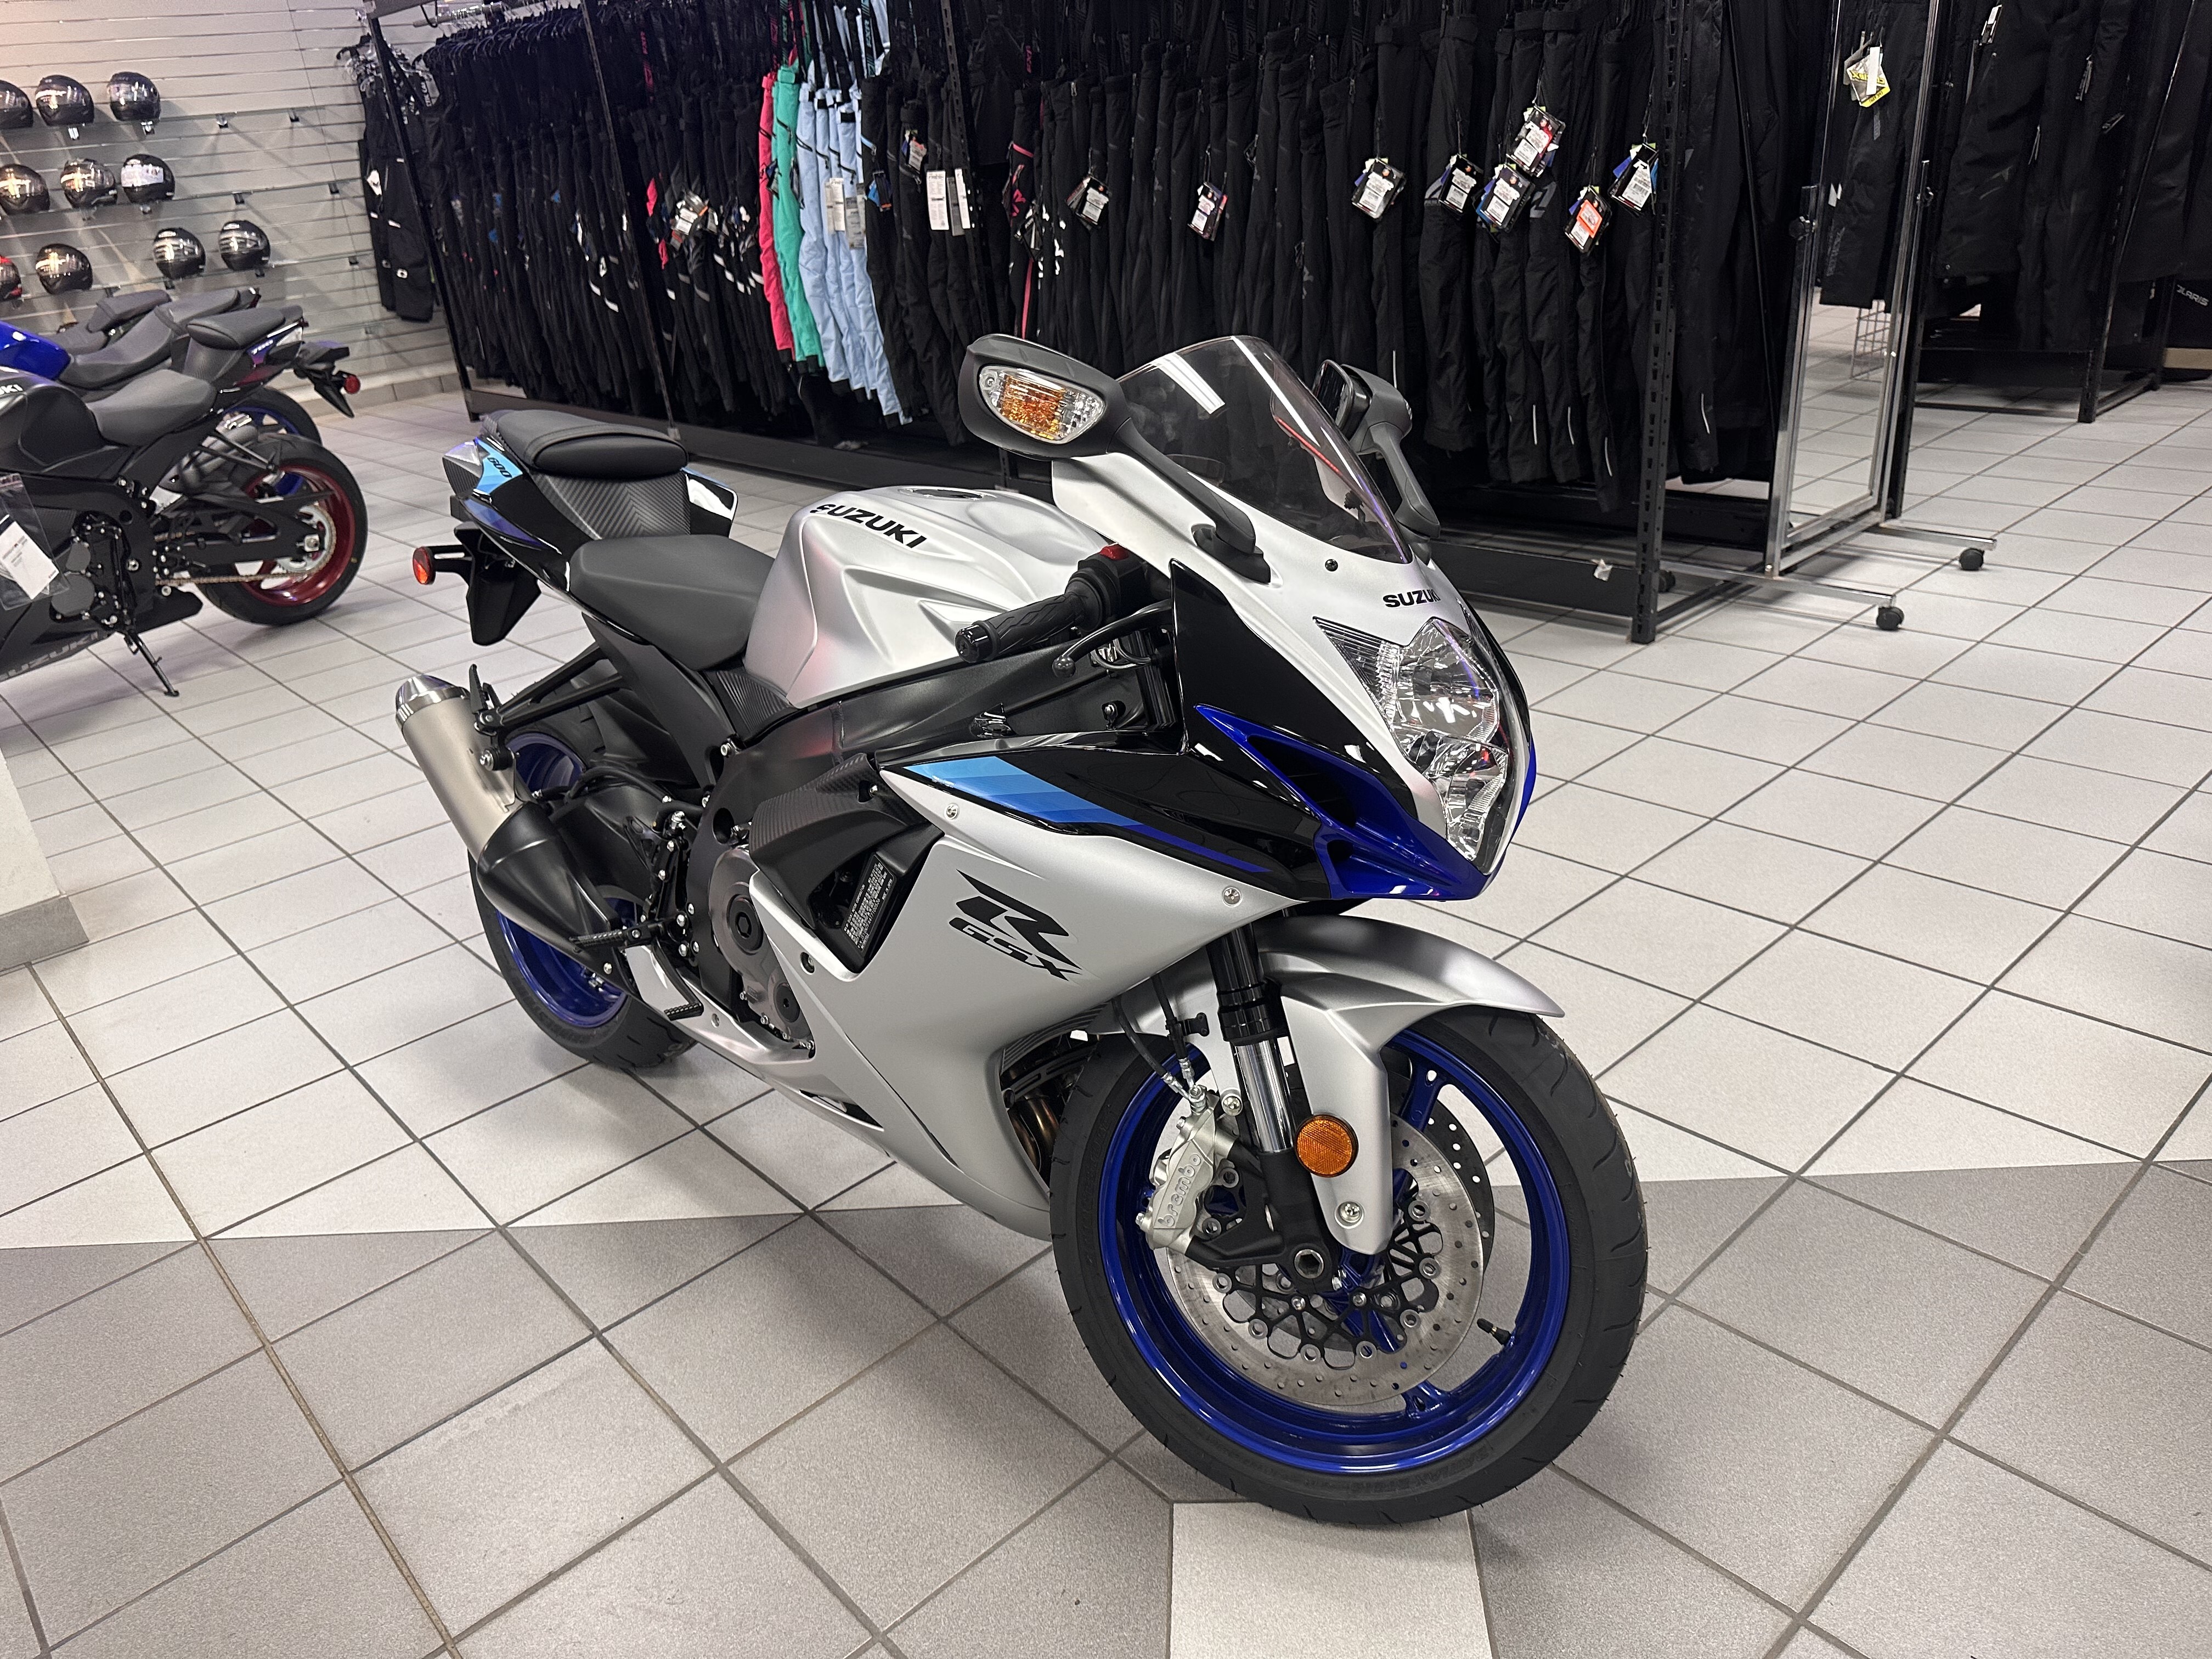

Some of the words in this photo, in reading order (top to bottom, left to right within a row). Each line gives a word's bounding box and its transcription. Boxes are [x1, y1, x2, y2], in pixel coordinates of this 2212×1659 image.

[487, 457, 512, 478] 600
[810, 503, 928, 549] SUZUKI
[1383, 589, 1441, 608] SUZUKI
[956, 869, 1082, 970] R
[949, 917, 1083, 982] GSX
[1157, 1154, 1201, 1227] brembo
